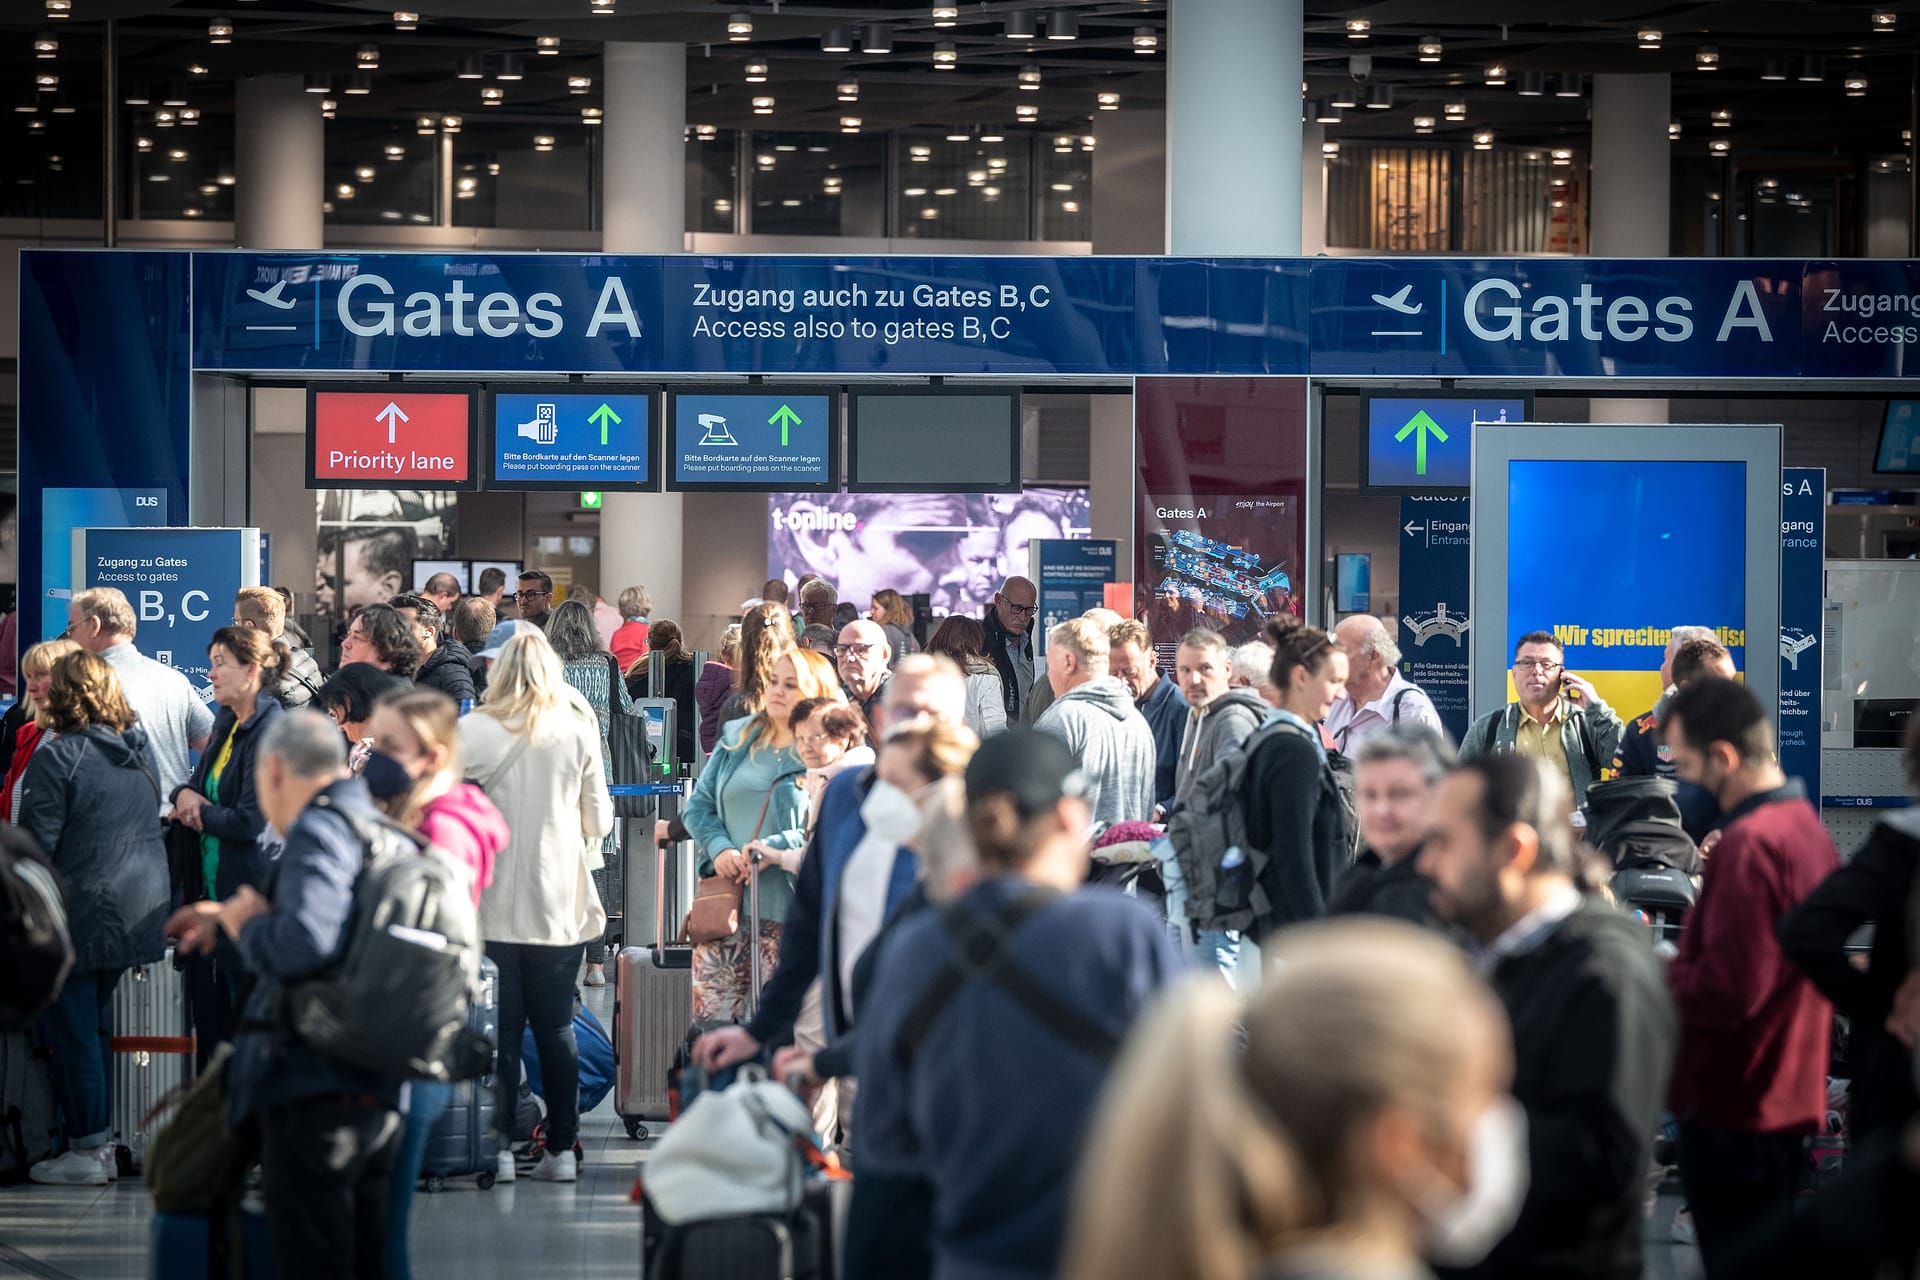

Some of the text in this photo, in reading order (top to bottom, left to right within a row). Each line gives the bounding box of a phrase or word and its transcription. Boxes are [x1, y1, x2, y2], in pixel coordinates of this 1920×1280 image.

[692, 283, 1051, 313] Zugang auch zu Gates B,C
[337, 273, 643, 338] Gates A
[1463, 278, 1774, 342] Gates A
[692, 314, 1011, 345] Access also to gates B,C
[1822, 321, 1918, 343] Access
[329, 450, 455, 474] Priority lane
[588, 454, 618, 462] Scanner
[620, 454, 640, 463] legen
[800, 456, 820, 464] legen
[540, 464, 571, 472] boarding
[708, 465, 719, 473] put
[720, 464, 751, 473] boarding
[1798, 479, 1813, 496] A
[136, 497, 158, 507] DUS
[1156, 508, 1207, 518] Gates A
[1782, 521, 1814, 533] gang
[1782, 538, 1817, 548] rance
[97, 557, 138, 568] Zugang
[155, 558, 188, 568] Gates
[97, 572, 178, 585] Access to gates
[140, 590, 210, 628] B,C
[1554, 624, 1589, 645] Wir
[1592, 626, 1672, 648] spreche
[160, 655, 168, 663] B
[1856, 798, 1872, 806] DUS
